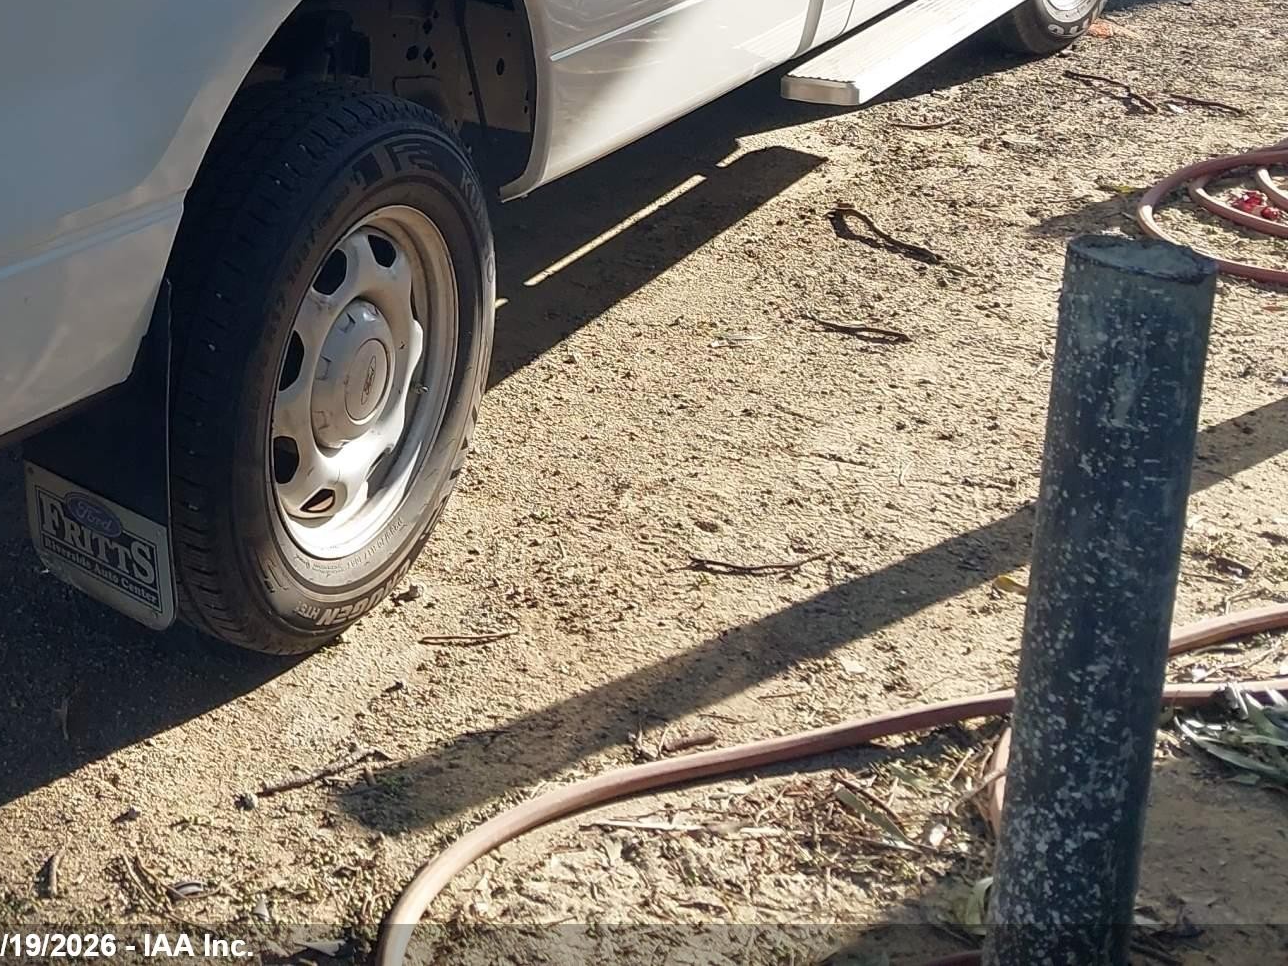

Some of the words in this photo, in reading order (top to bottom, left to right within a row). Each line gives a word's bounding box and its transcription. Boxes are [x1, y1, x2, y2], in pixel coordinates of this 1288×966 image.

[74, 499, 113, 532] Ford
[38, 492, 156, 585] FRITTS
[93, 560, 120, 585] Auto
[120, 575, 158, 605] Center
